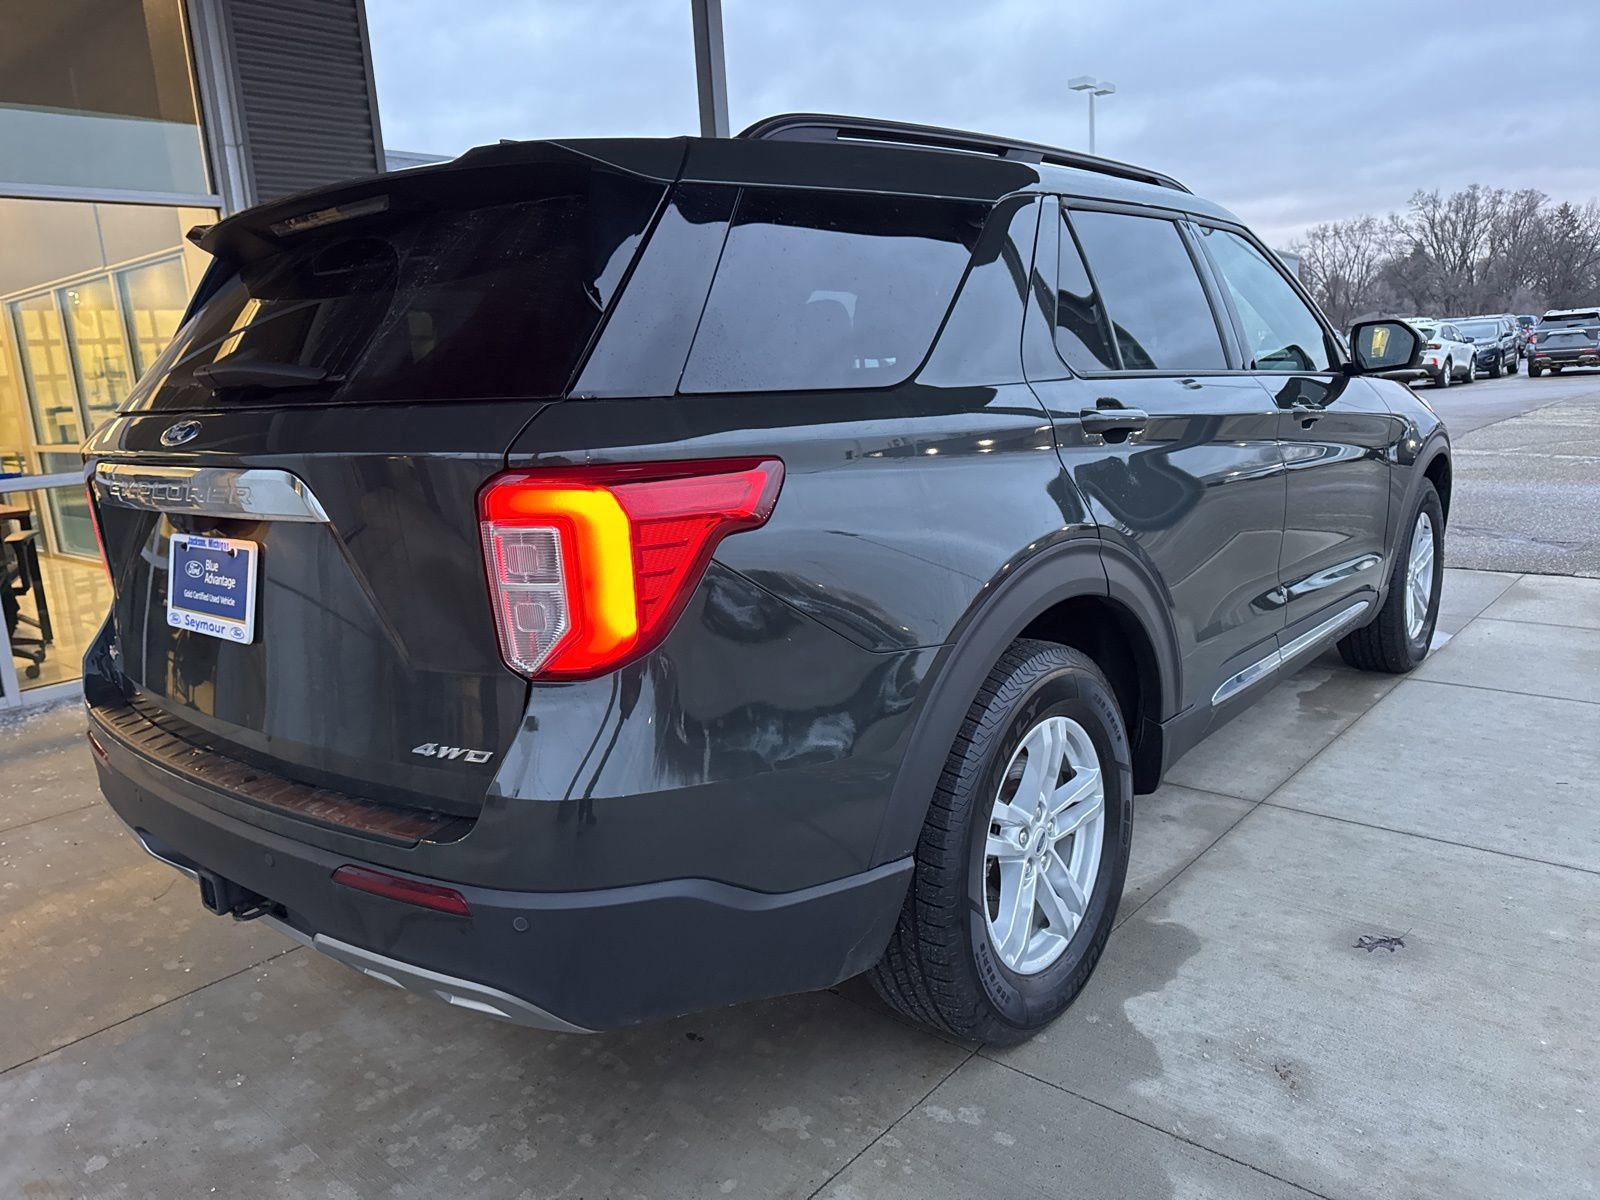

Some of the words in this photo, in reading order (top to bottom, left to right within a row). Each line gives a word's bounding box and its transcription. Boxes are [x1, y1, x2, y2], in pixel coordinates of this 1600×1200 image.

[110, 480, 253, 505] EXPLORER
[205, 559, 219, 572] Blue
[204, 573, 236, 590] Advantage
[183, 588, 193, 599] Gold
[193, 590, 209, 602] Certified
[220, 596, 236, 607] Vehicle
[184, 614, 226, 635] Seymour
[411, 742, 494, 764] 4WD
